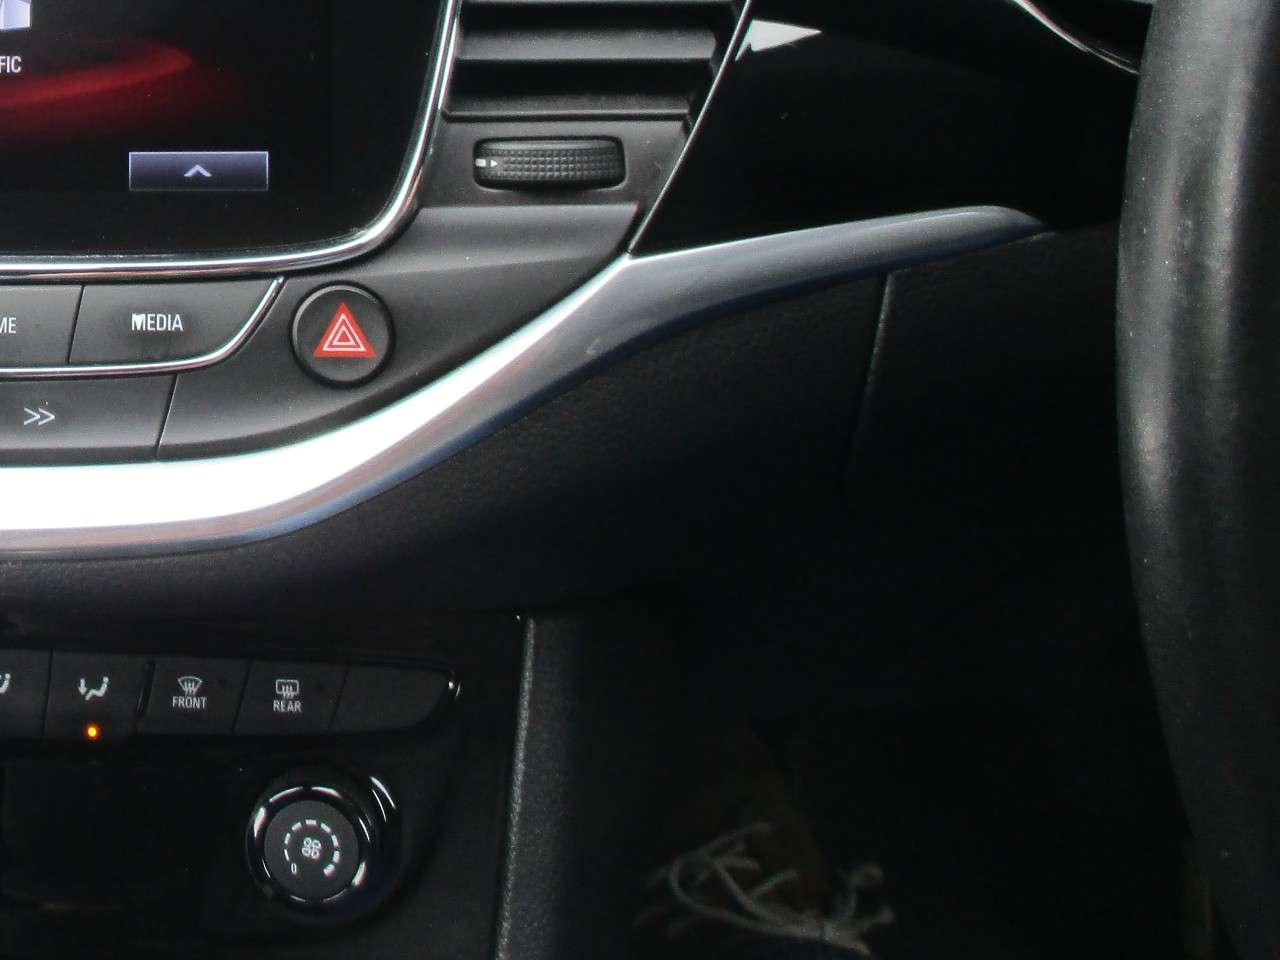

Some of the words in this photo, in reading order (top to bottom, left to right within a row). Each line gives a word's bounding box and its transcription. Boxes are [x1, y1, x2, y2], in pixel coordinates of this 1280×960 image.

[131, 313, 184, 332] MEDIA
[171, 695, 208, 710] FRONT
[272, 699, 302, 713] REAR
